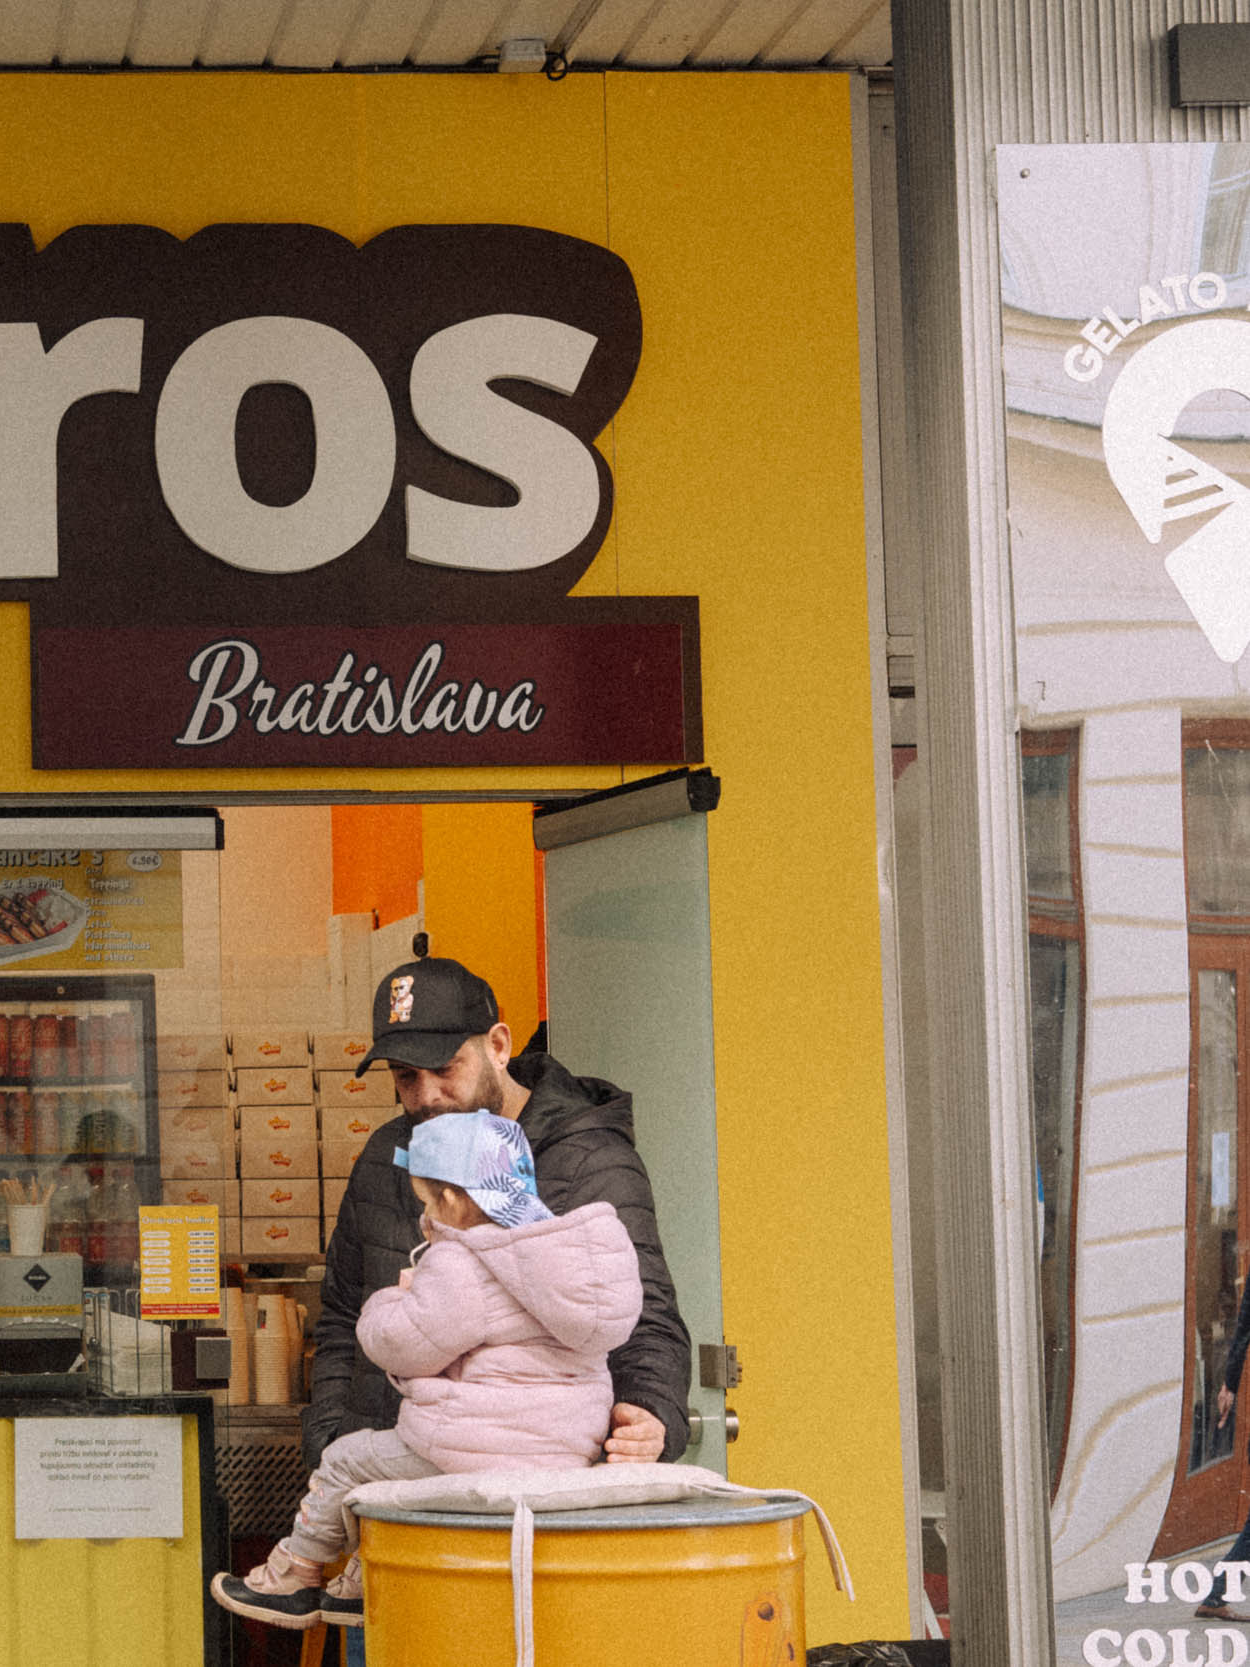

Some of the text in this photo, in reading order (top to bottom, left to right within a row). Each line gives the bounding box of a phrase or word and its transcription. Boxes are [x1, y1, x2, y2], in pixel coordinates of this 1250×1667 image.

[1064, 272, 1227, 382] GELATO
[175, 639, 543, 746] Bratislava
[1124, 1561, 1250, 1604] HOT
[1082, 1628, 1249, 1667] COLD
